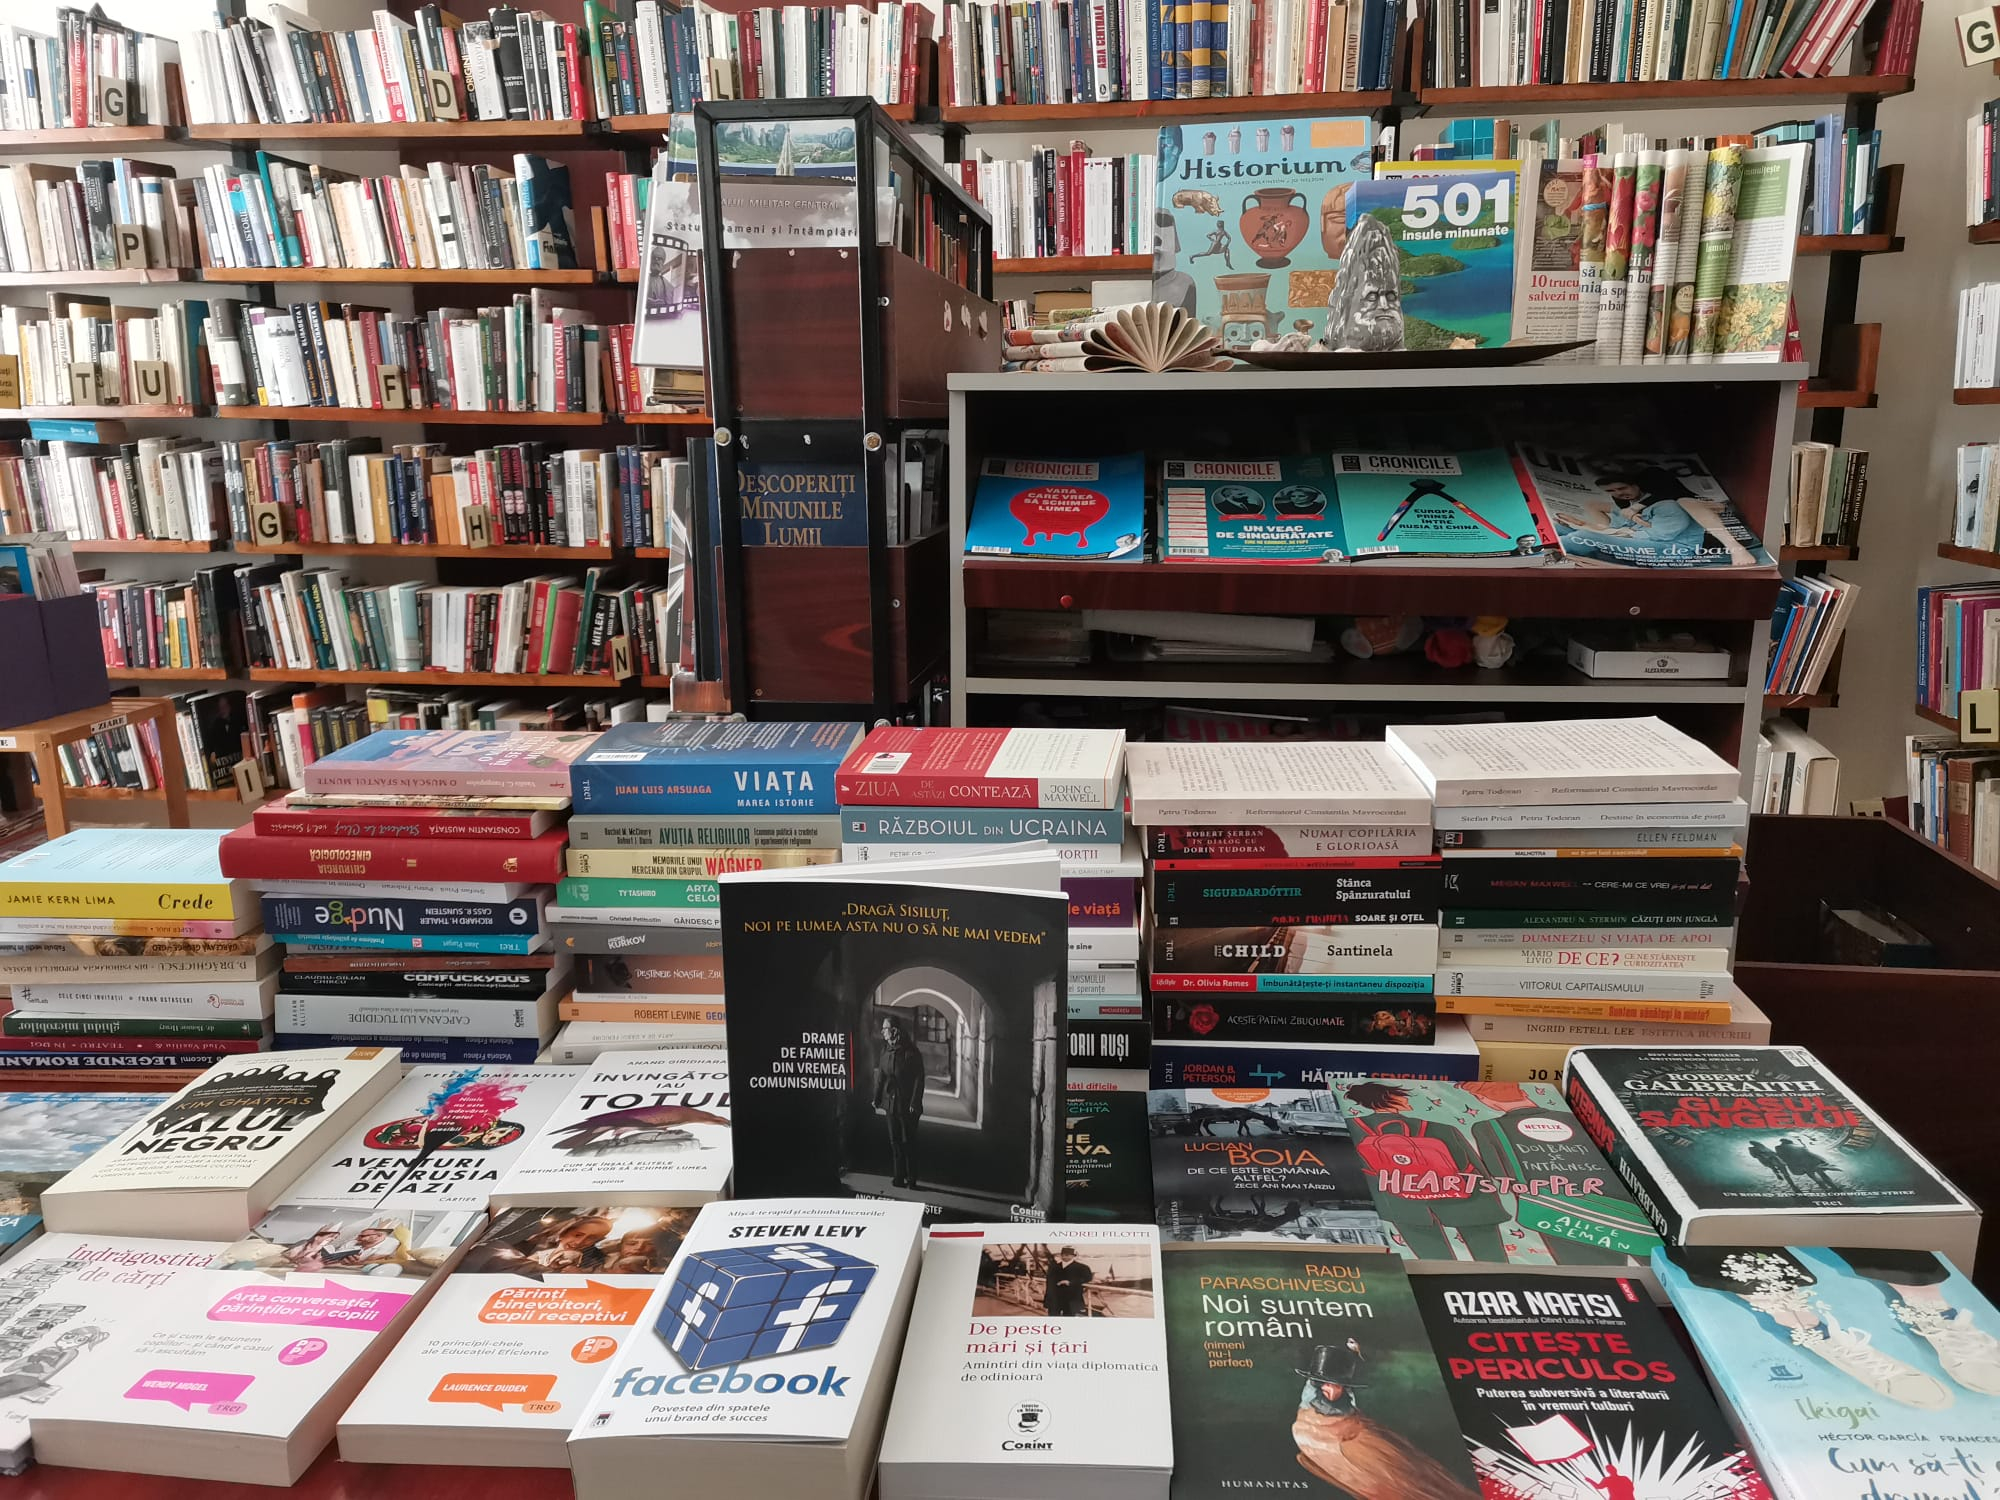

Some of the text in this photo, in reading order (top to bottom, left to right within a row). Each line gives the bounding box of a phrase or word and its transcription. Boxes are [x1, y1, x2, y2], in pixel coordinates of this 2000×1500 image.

[1966, 21, 1995, 53] G
[715, 69, 730, 97] L
[432, 78, 451, 107] D
[104, 88, 124, 116] G
[1180, 158, 1346, 181] Historium
[1401, 179, 1511, 229] 501
[1402, 226, 1509, 240] insule minunate
[122, 233, 139, 260] P
[554, 325, 563, 380] ISTANBUL
[76, 373, 90, 399] T
[142, 370, 161, 396] U
[384, 374, 396, 401] F
[1014, 461, 1094, 475] CRONICILE
[1193, 463, 1275, 475] CRONICILE
[1369, 456, 1454, 470] CRONICILE
[742, 496, 843, 520] MINUNILE
[258, 512, 278, 538] G
[470, 514, 484, 541] H
[1243, 524, 1304, 532] UN VEAC
[764, 522, 822, 546] LUMII
[1237, 529, 1333, 539] SINGURĂTATE
[1571, 536, 1688, 556] COSTUME de
[593, 612, 604, 646] HITLER
[614, 646, 627, 672] N
[98, 716, 124, 731] ZIARE
[1969, 702, 1992, 734] L
[616, 786, 712, 795] JUAN LUIS ARSUAGA
[734, 770, 814, 796] VIAȚA
[1051, 784, 1093, 794] JOHN C.
[1044, 792, 1100, 802] MAXWELL
[879, 816, 1107, 836] RĂZBOIUL DIN UCRAINA
[1300, 827, 1416, 838] NUMAI COPILĂRIA
[1316, 840, 1398, 851] E GLORIOASĂ
[310, 850, 371, 862] GINECOLOGICĂ
[652, 856, 686, 864] MEMORIILE
[318, 864, 366, 873] CHIRURGIA
[632, 857, 762, 876] MERCENAR DIN GRUPUL WAGNER
[1337, 878, 1371, 888] Stânca
[1203, 886, 1301, 897] SIGURDARDÓTTIR
[1336, 889, 1410, 901] Spânzuratului
[48, 896, 80, 904] KERN
[86, 897, 115, 905] LIMA
[158, 894, 213, 909] Crede
[315, 901, 403, 932] Nudge
[420, 917, 449, 925] THALER
[1223, 945, 1393, 957] CHILD Santinela
[403, 974, 530, 983] CONFUCKYOUS
[1520, 981, 1644, 993] VIITORUL CAPITALISMULUI
[18, 1021, 120, 1035] ghidul microbilor
[802, 1032, 845, 1045] DRAME
[781, 1048, 845, 1060] DE FAMILIE
[772, 1062, 845, 1075] DIN VREMEA
[1183, 1064, 1224, 1074] JORDAN
[750, 1077, 845, 1090] COMUNISMULUI
[1183, 1074, 1236, 1083] PETERSON
[1666, 1072, 1756, 1082] ROBERT
[1623, 1079, 1823, 1092] GALBRAITH
[176, 1096, 313, 1111] KIM GHATTAS
[1678, 1098, 1837, 1112] GLASUL
[121, 1136, 282, 1155] NEGRU
[1185, 1143, 1252, 1152] LUCIAN
[332, 1157, 484, 1168] AVENTURI
[1227, 1150, 1325, 1166] BOIA
[360, 1168, 498, 1181] ÎN RUSIA
[348, 1183, 454, 1193] DE AZI
[1378, 1169, 1605, 1197] HEARTSTOPPER
[729, 1225, 867, 1239] STEVEN LEVY
[1556, 1216, 1619, 1237] ALICE
[1538, 1220, 1630, 1250] OSEMAN
[68, 1244, 216, 1268] Îndrăgostită
[78, 1268, 176, 1288] de cărți
[1306, 1264, 1360, 1279] RADU
[1200, 1277, 1366, 1294] PARASCHIVESCU
[230, 1291, 379, 1310] Arta conversației
[1202, 1295, 1373, 1318] Noi suntem
[1444, 1291, 1622, 1318] AZAR NAFISI
[217, 1303, 380, 1322] părinților cu copiii
[969, 1322, 1062, 1338] De peste
[1205, 1318, 1312, 1338] români
[966, 1341, 1088, 1355] mări și țări
[1468, 1332, 1632, 1356] CITEȘTE
[963, 1361, 1159, 1373] Amintiri din viața diplomatică
[1449, 1358, 1676, 1382] PERICULOS
[612, 1365, 852, 1397] facebook
[960, 1373, 1043, 1382] de odinioară
[1794, 1397, 1880, 1429] Ikigai
[1222, 1480, 1308, 1488] HUMANITAS
